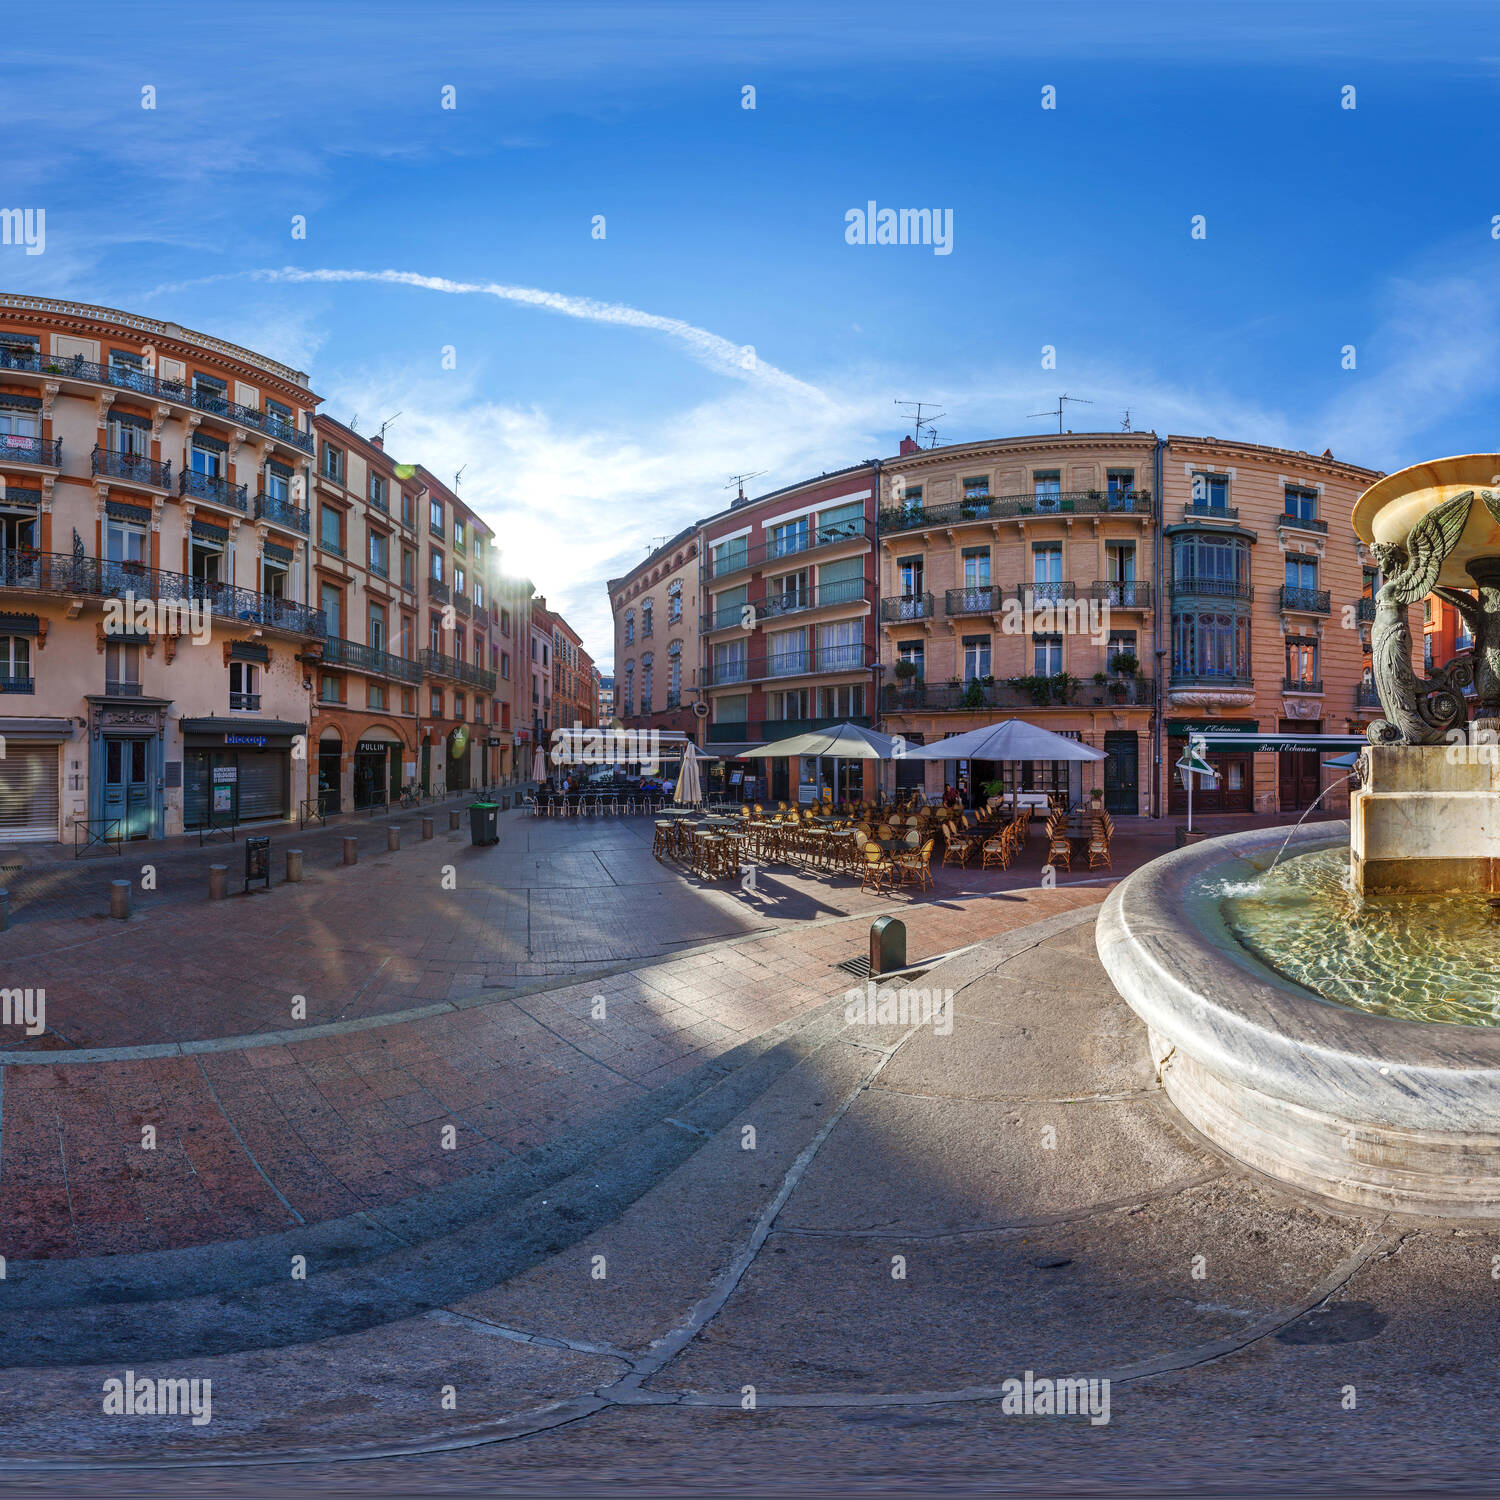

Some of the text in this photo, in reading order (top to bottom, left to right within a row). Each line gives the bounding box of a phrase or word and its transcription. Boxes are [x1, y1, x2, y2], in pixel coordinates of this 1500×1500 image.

[1182, 724, 1199, 732] Bar
[225, 733, 267, 747] biocoop
[361, 743, 384, 751] PULLIN
[1259, 744, 1317, 753] Bar l'Echanson
